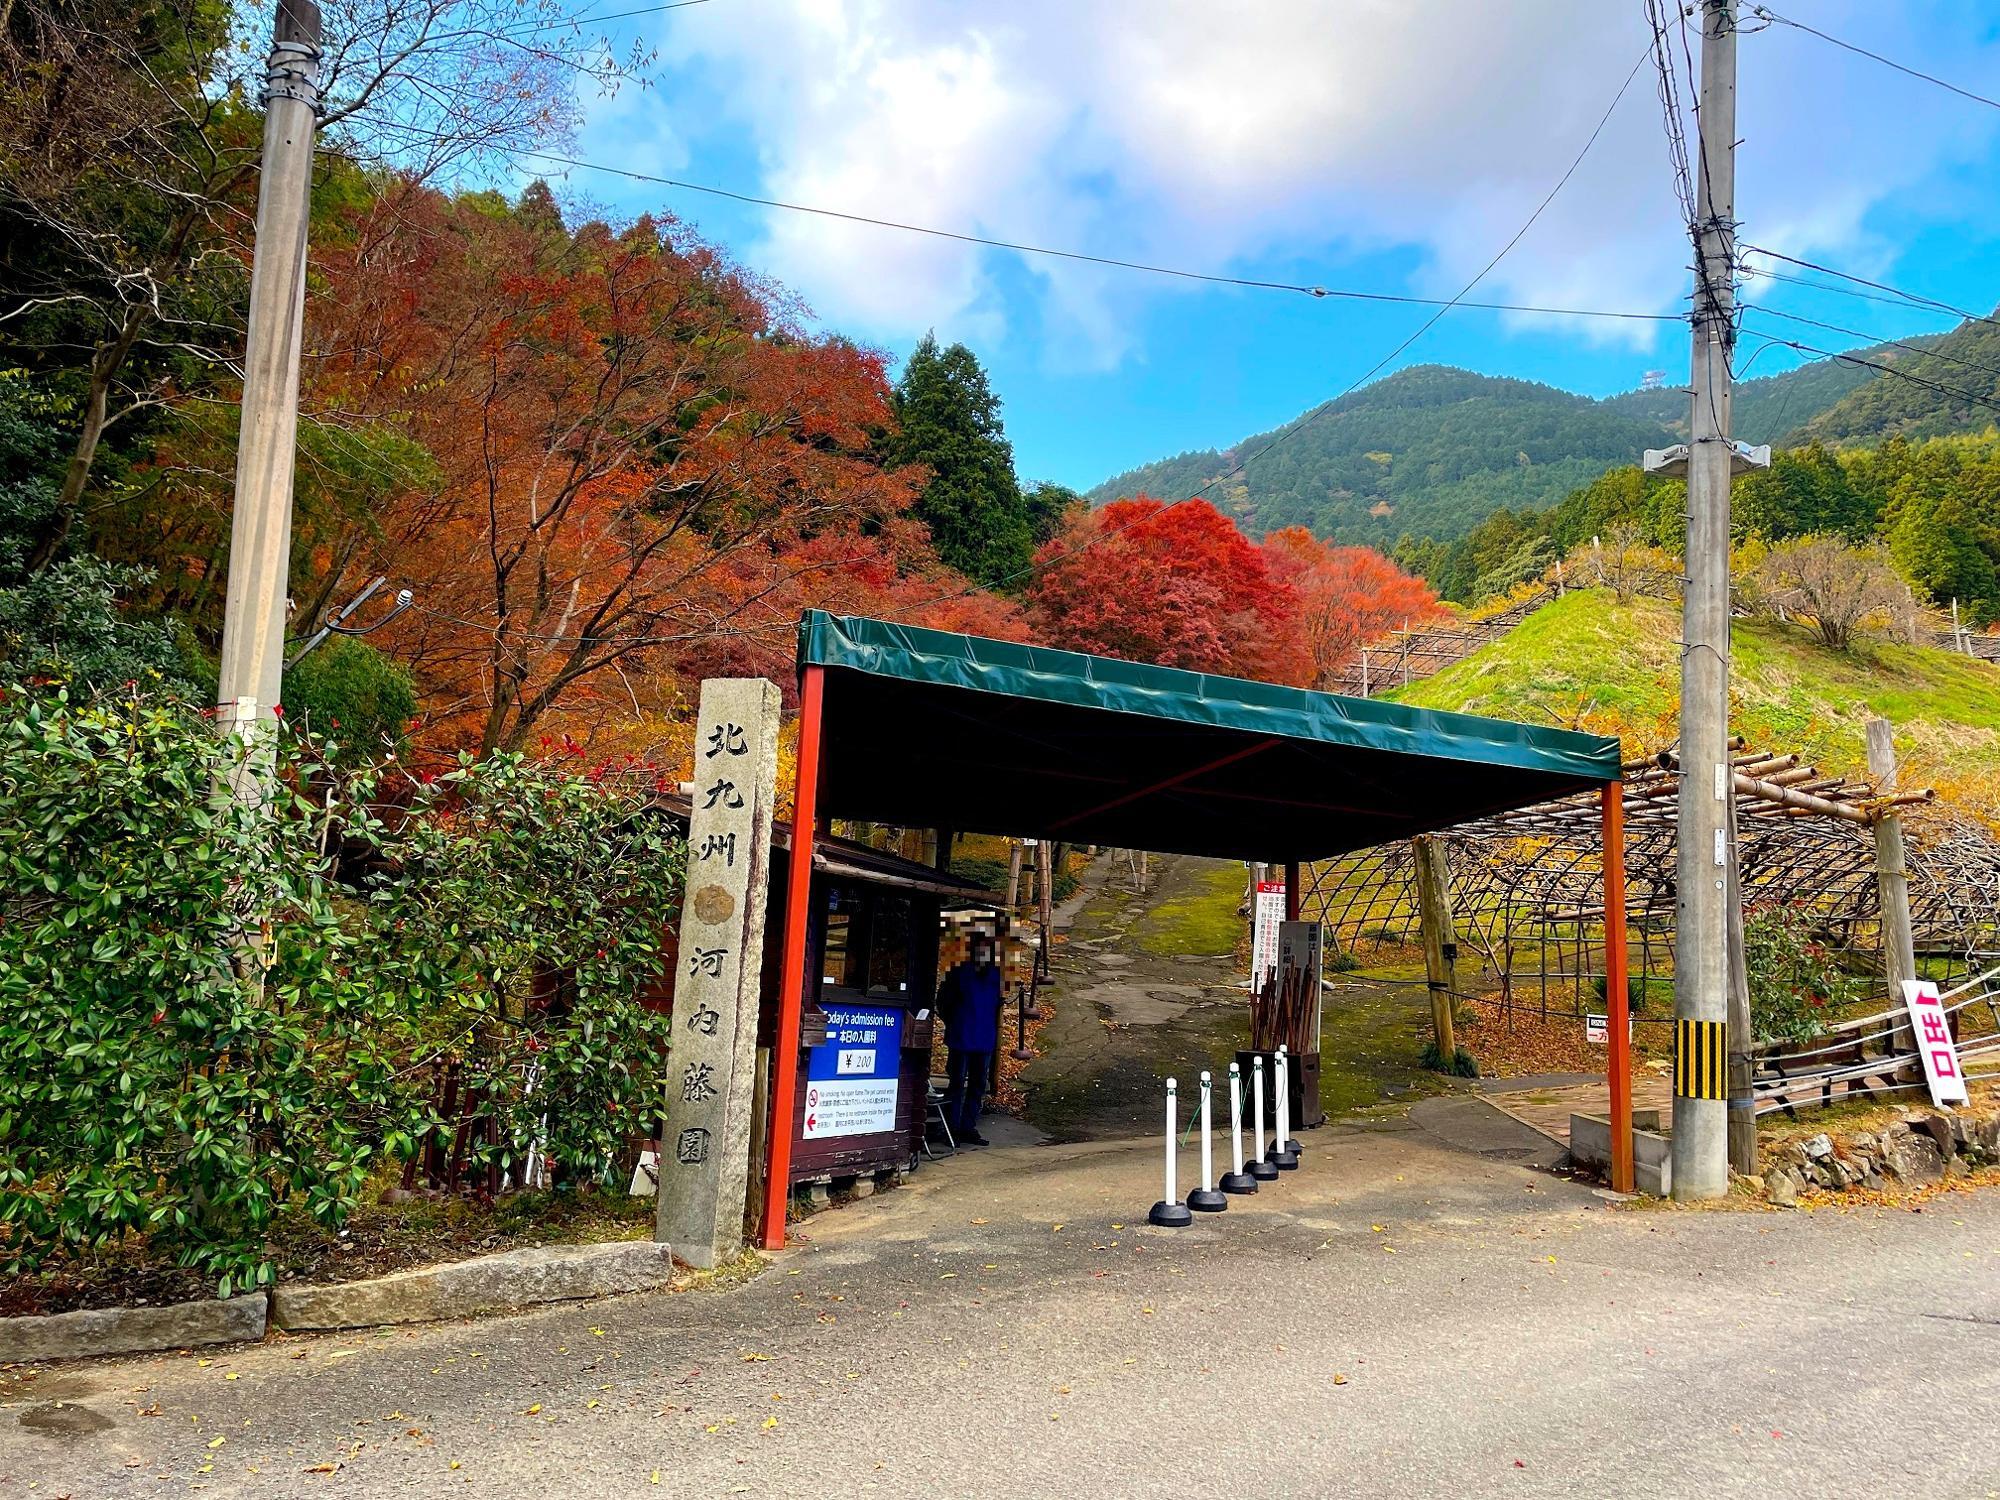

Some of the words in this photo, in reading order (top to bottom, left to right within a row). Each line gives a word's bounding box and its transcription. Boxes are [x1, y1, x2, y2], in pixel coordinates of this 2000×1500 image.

[701, 723, 749, 867] 北九州
[851, 1012, 883, 1026] admission
[885, 1013, 895, 1027] fee
[1921, 1012, 1956, 1078] 出口
[676, 946, 729, 1165] 河内藤園
[857, 1056, 871, 1068] 200
